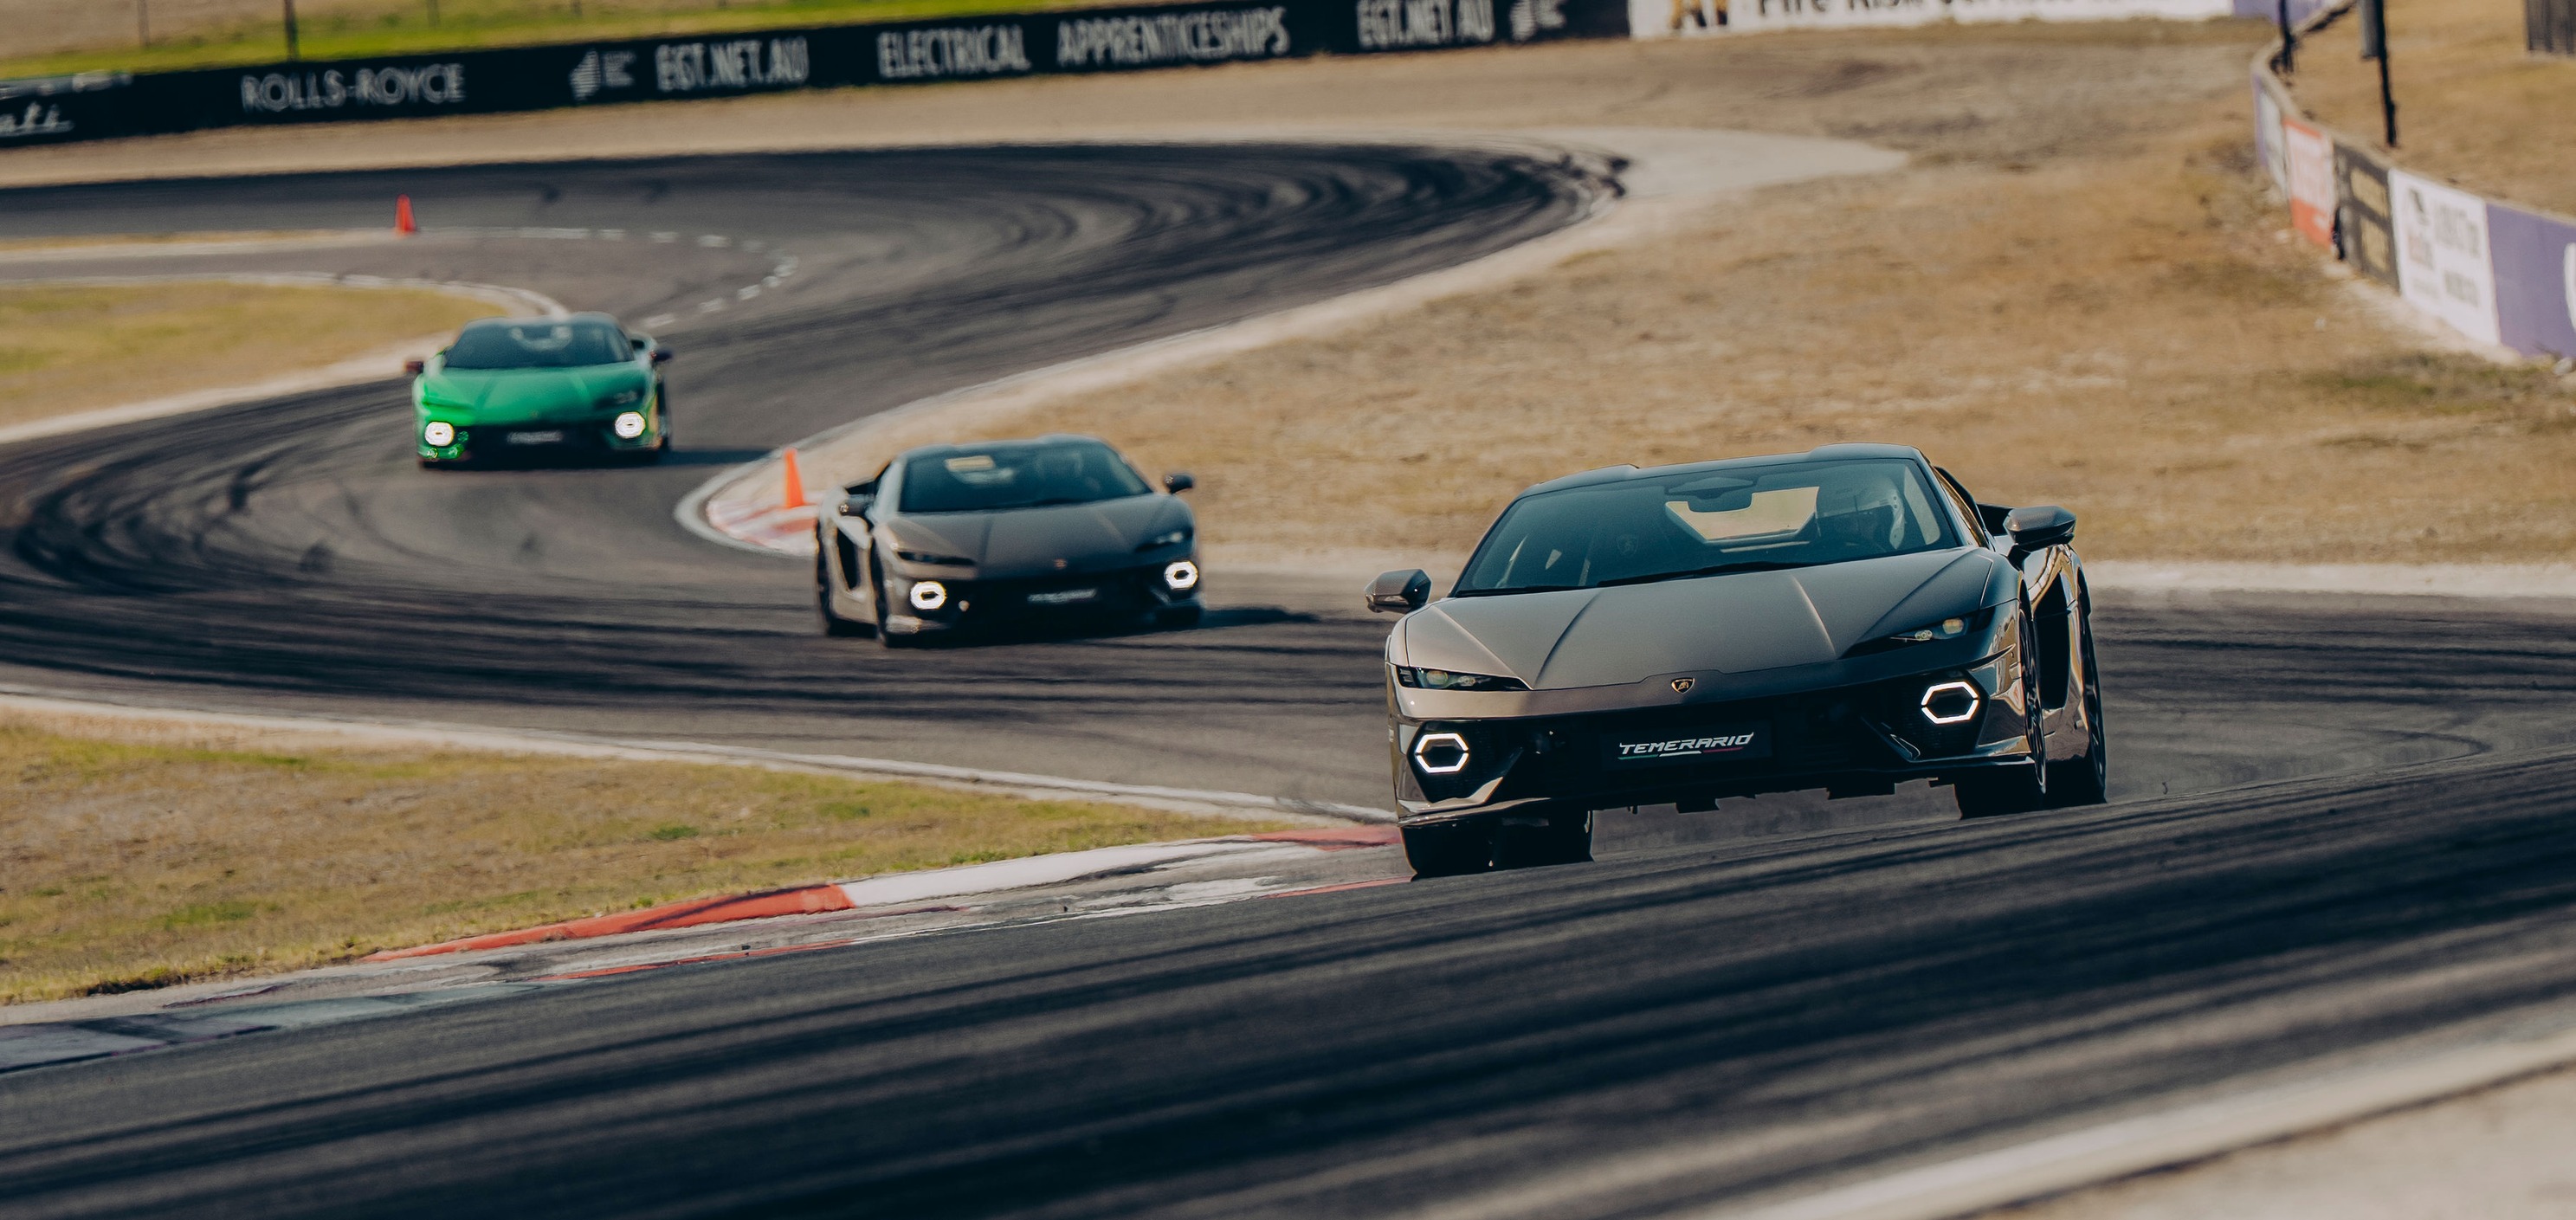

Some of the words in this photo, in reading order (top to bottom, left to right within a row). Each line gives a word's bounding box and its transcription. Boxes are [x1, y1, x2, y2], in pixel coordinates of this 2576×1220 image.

[877, 25, 1030, 78] ELECTRICAL
[1057, 6, 1289, 66] APPRENTICESHIPS
[241, 63, 464, 112] ROLLS-ROYCE
[1619, 732, 1754, 755] TEMERARIO
